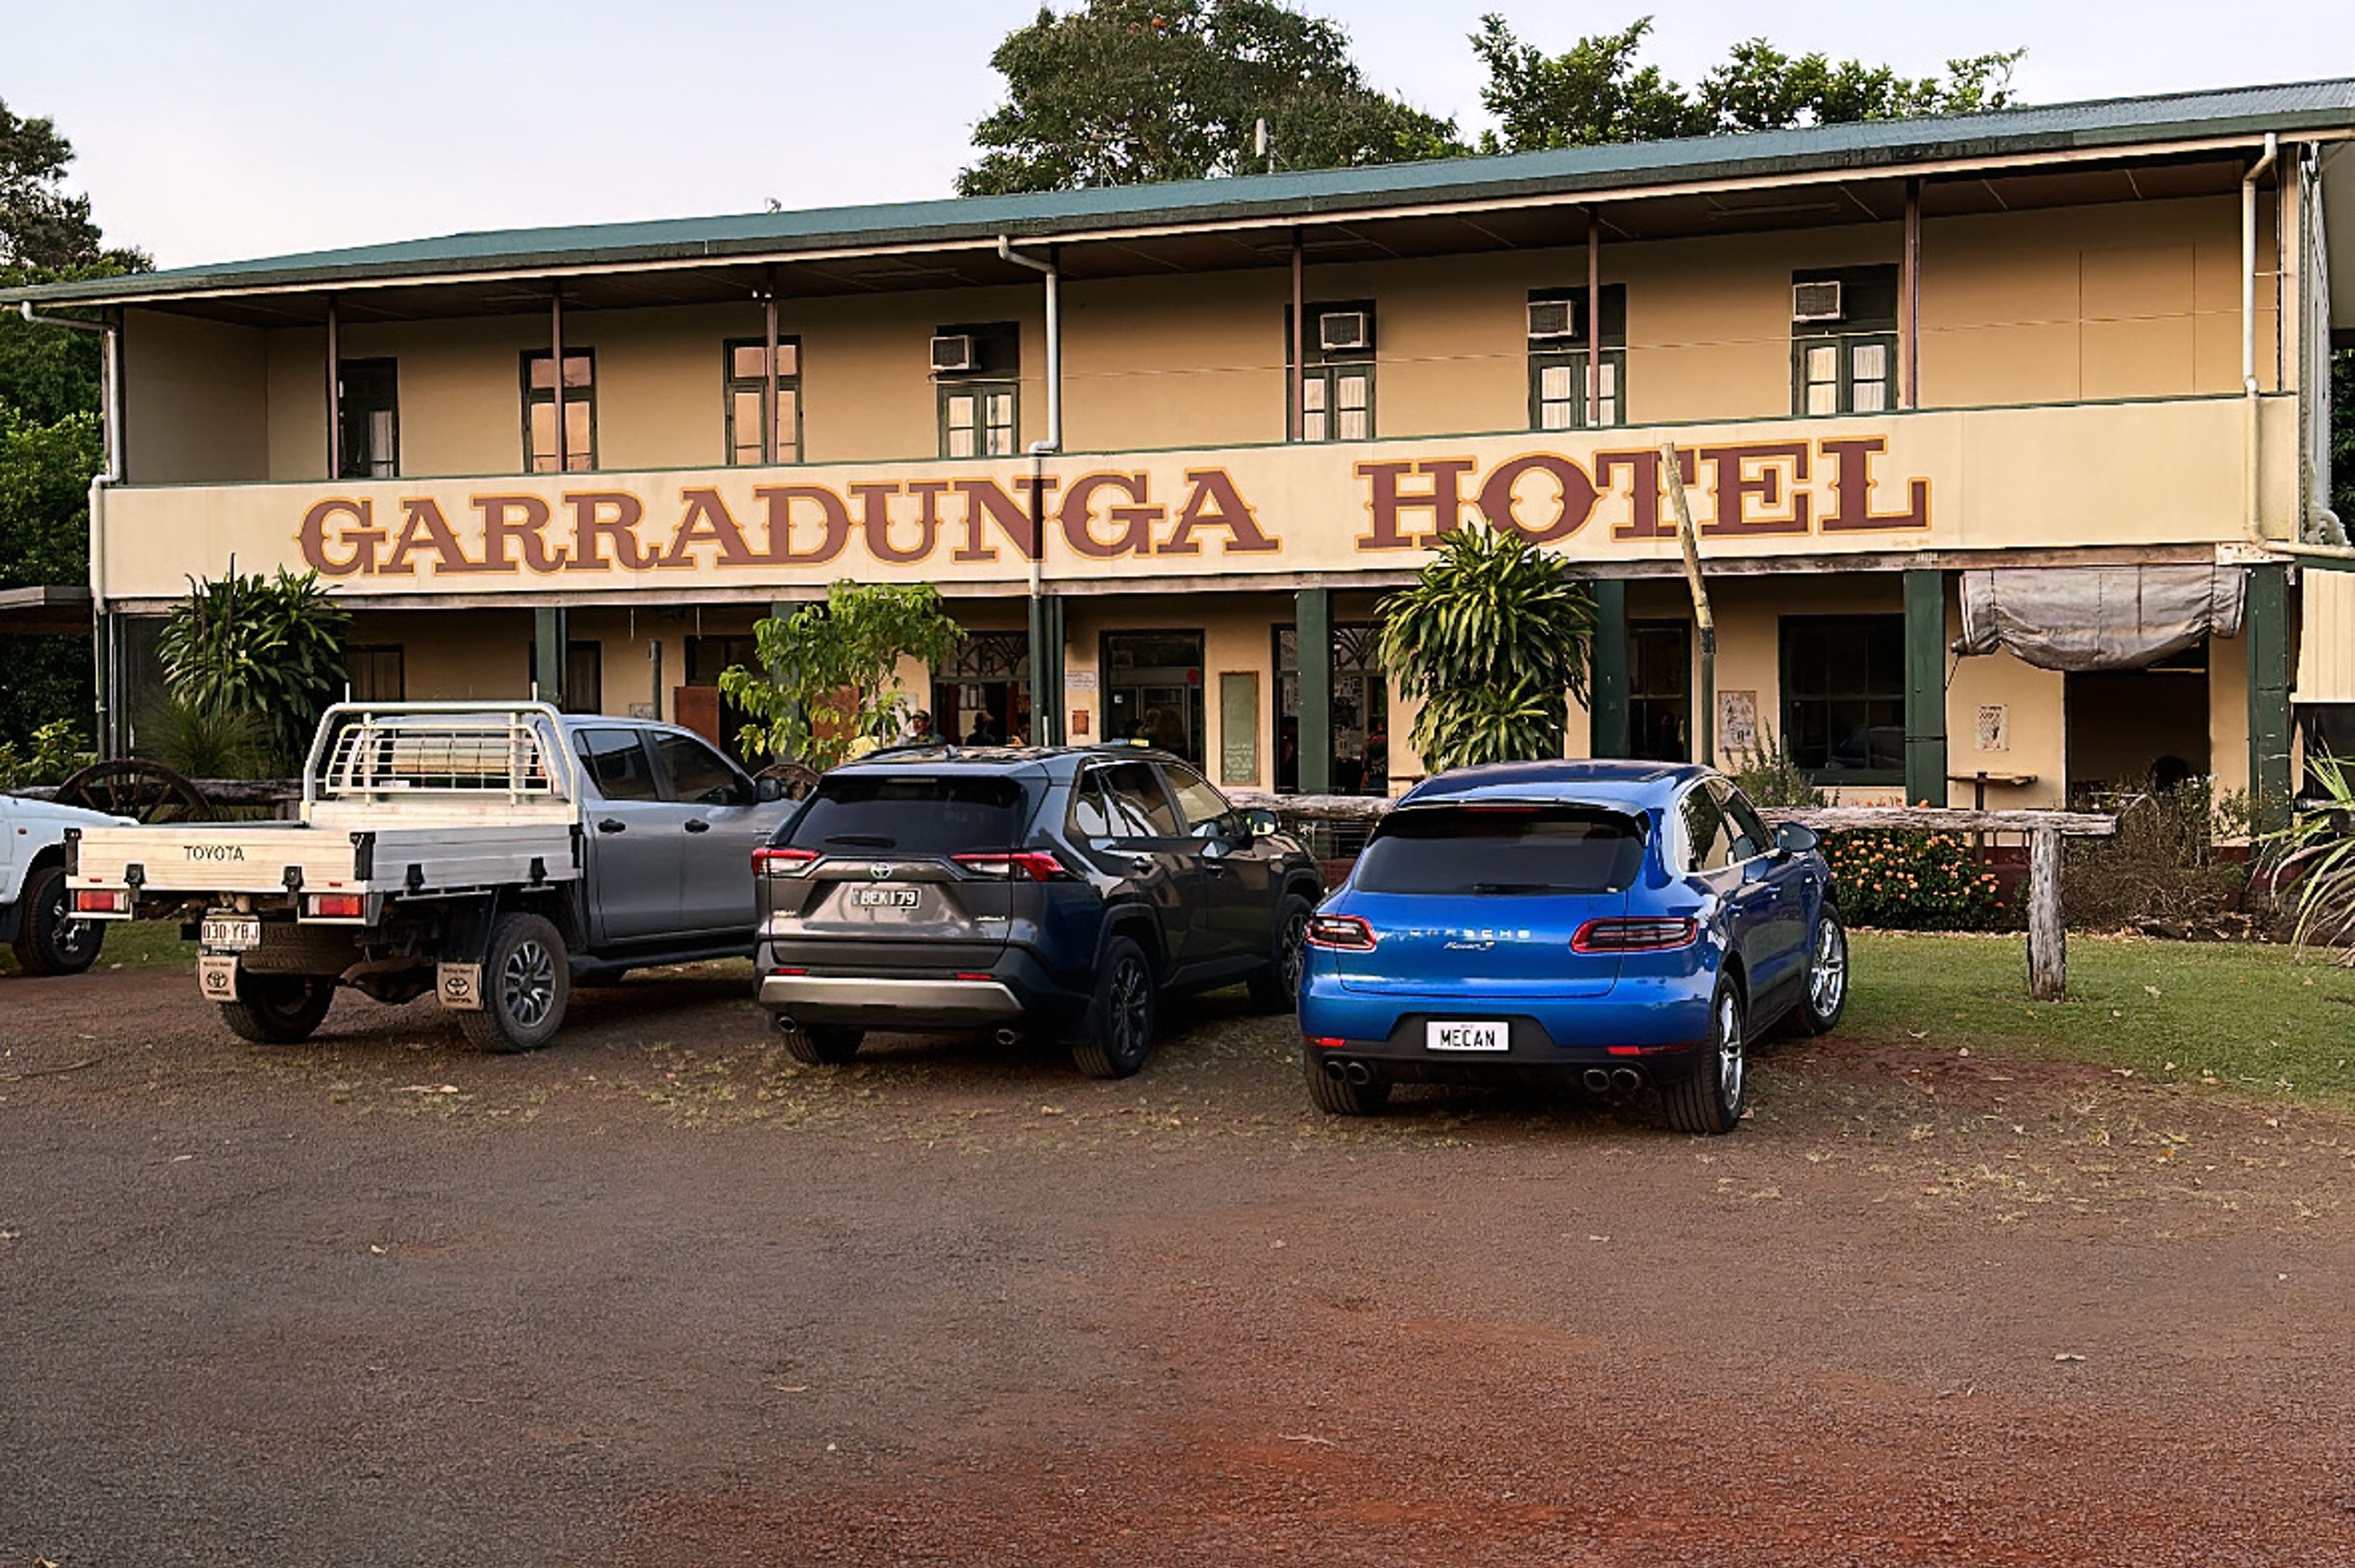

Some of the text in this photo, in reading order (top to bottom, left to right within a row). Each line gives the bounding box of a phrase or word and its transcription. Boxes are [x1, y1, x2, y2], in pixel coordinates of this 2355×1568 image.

[293, 435, 1931, 578] GARRADUNGA HOTEL
[183, 845, 244, 861] TOYOTA
[1440, 1029, 1495, 1047] MECAN
